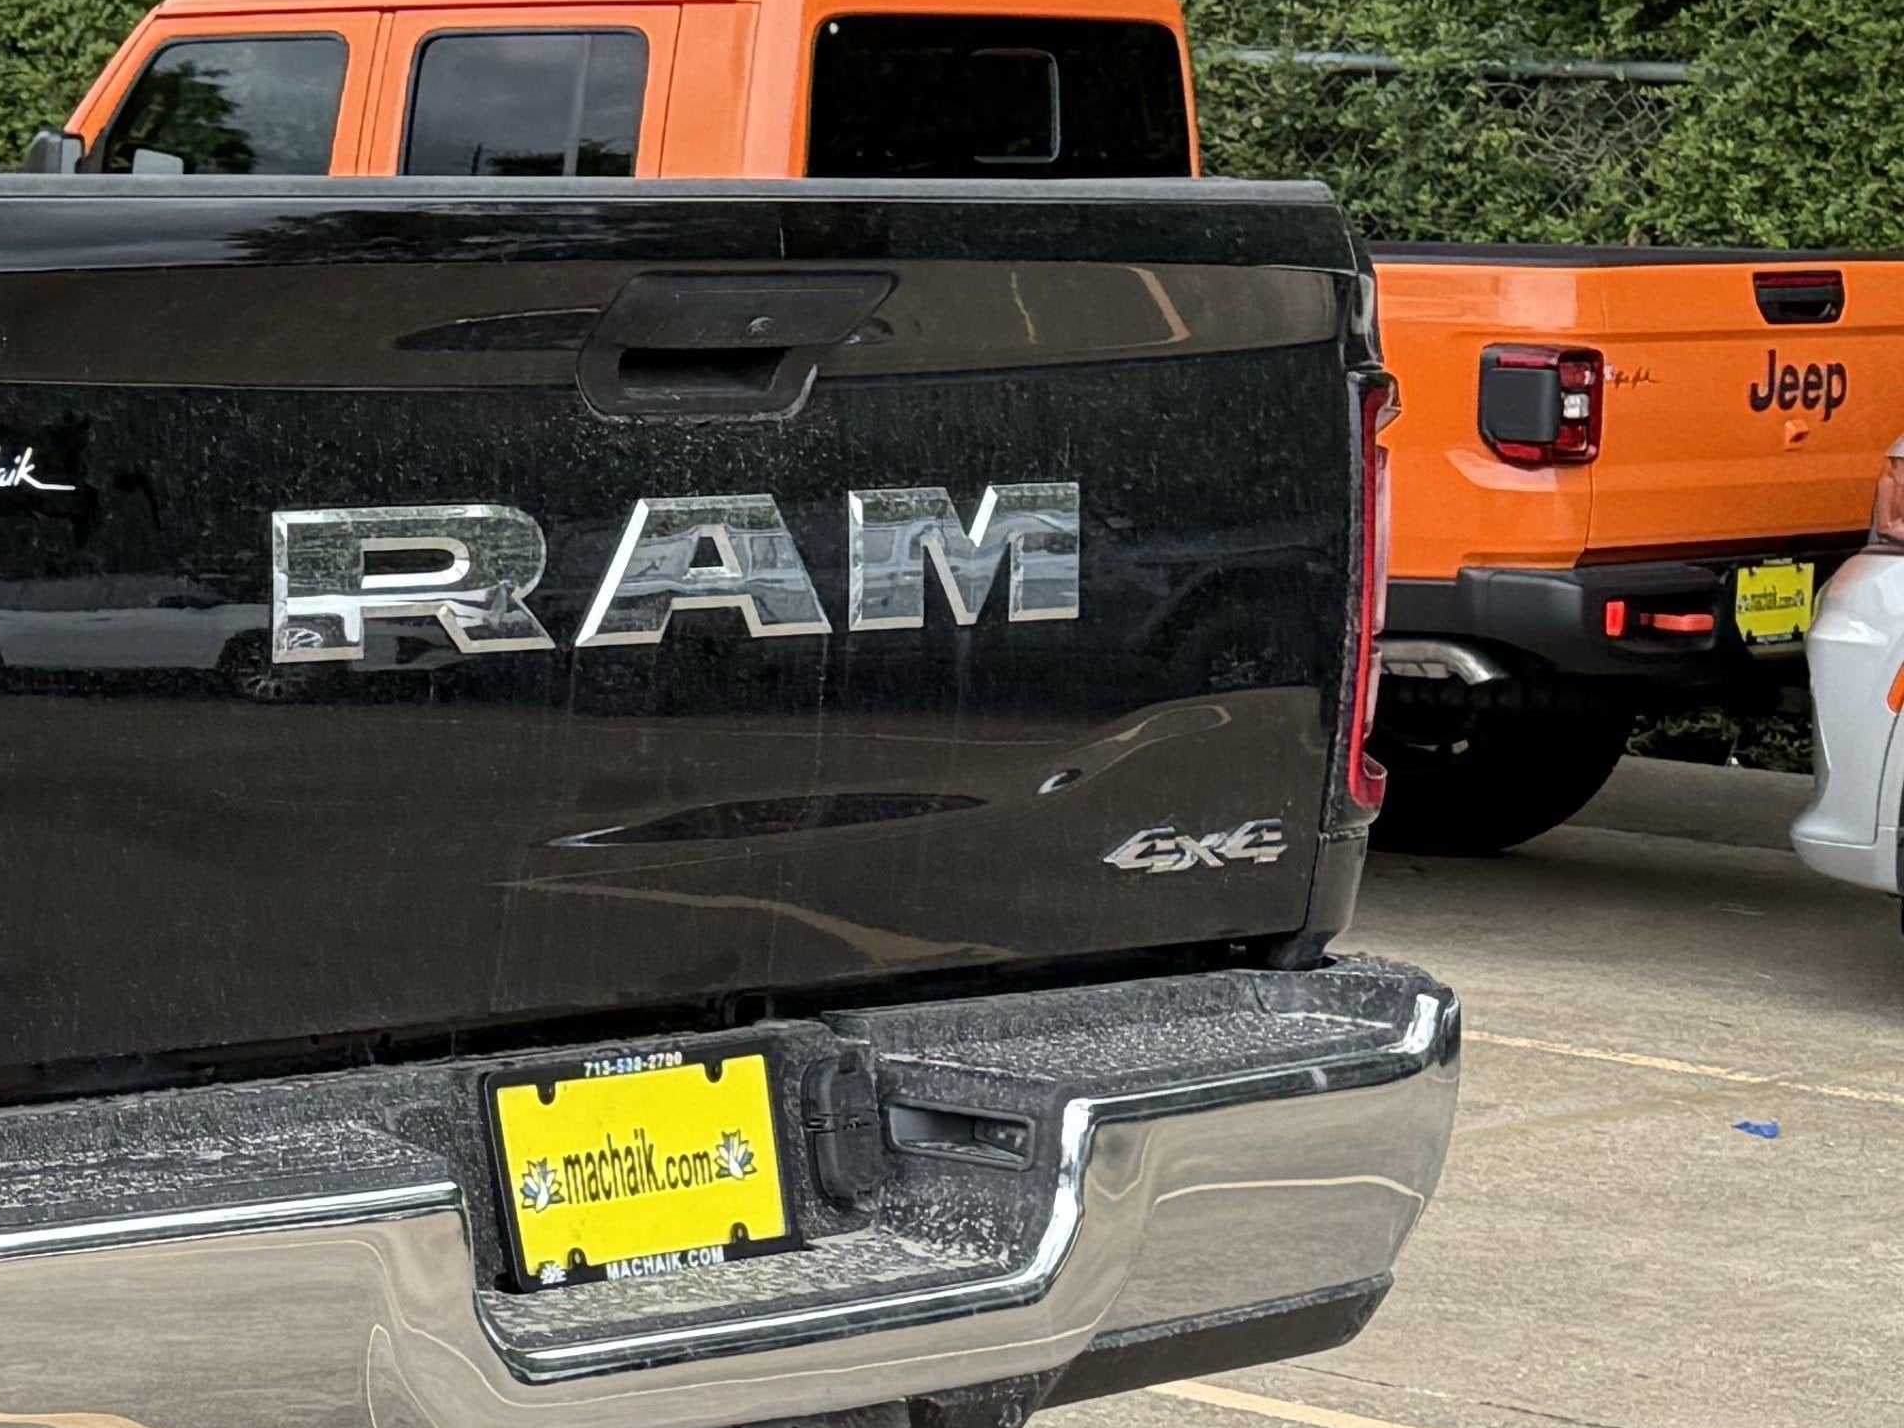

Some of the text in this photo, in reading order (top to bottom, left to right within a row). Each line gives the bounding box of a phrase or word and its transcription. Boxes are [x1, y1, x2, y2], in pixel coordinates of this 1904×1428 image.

[1749, 348, 1847, 422] Jeep
[272, 482, 1080, 664] RAM
[562, 1127, 714, 1205] machaik.com
[605, 1245, 725, 1281] MACHAIK.COM
